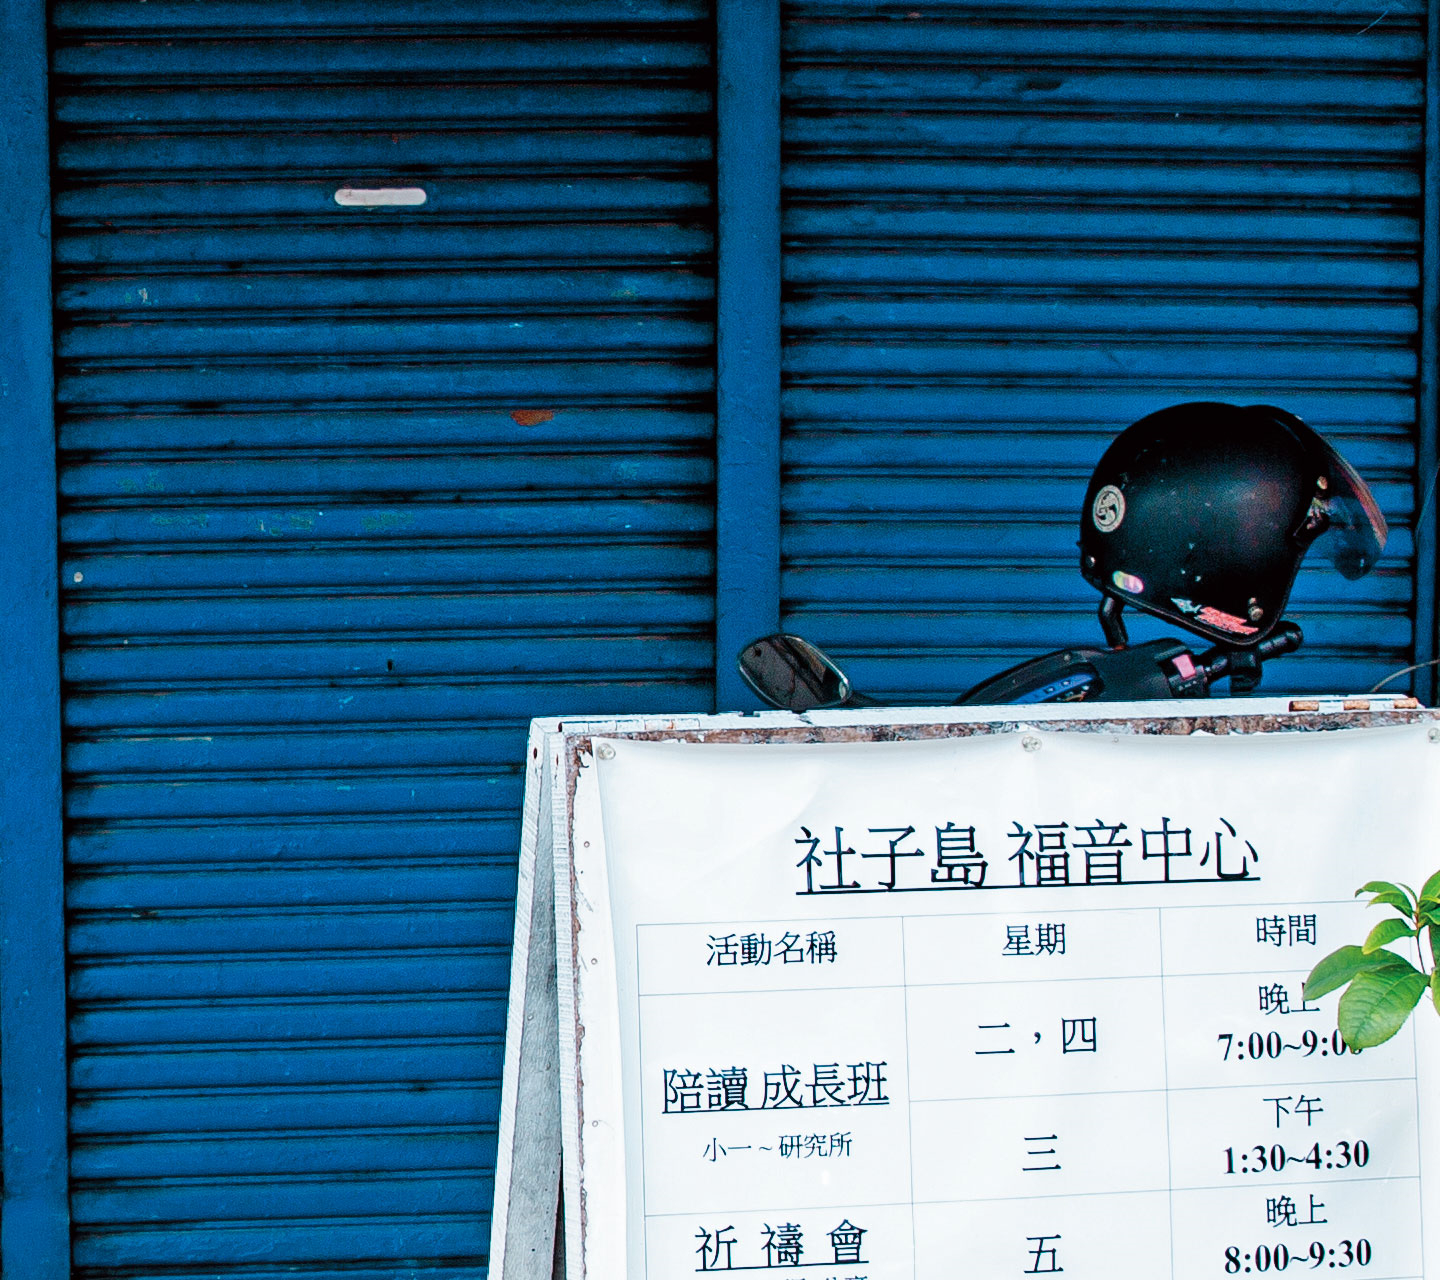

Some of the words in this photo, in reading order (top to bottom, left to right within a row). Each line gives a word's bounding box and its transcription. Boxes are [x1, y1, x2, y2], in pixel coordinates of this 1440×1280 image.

[795, 823, 990, 893] 社子島
[1006, 816, 1260, 889] 福音中心
[705, 929, 839, 968] 活動名稱
[1001, 923, 1066, 958] 星期
[1256, 914, 1317, 947] 時間
[1259, 982, 1320, 1016] 晚上
[975, 1017, 1099, 1056] 二，四
[1218, 1029, 1362, 1061] 7:00~9:0
[661, 1068, 749, 1114] 陪讀
[761, 1061, 889, 1110] 成長班
[1262, 1095, 1325, 1129] 下午
[1022, 1134, 1062, 1173] 三
[1222, 1140, 1371, 1176] 1:30~4:30
[1265, 1193, 1328, 1228] 晚上
[1024, 1233, 1065, 1275] 五
[1224, 1237, 1373, 1275] 8:00~9:30
